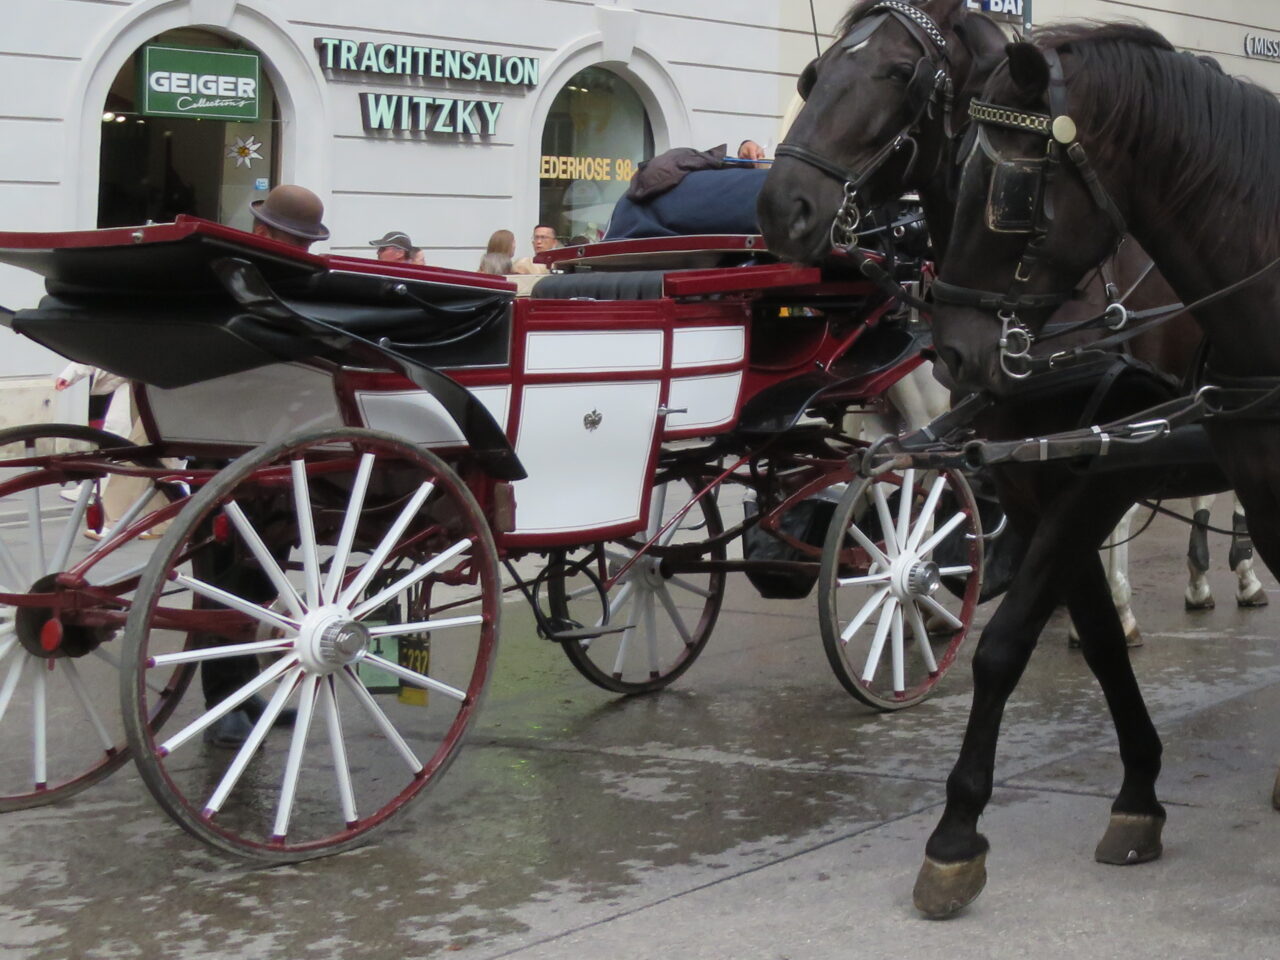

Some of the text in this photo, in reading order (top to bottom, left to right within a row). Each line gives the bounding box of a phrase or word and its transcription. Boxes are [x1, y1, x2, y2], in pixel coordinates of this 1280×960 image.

[317, 37, 540, 87] TRACHTENSALON
[149, 71, 257, 98] GEIGER
[364, 93, 504, 136] WITZKY
